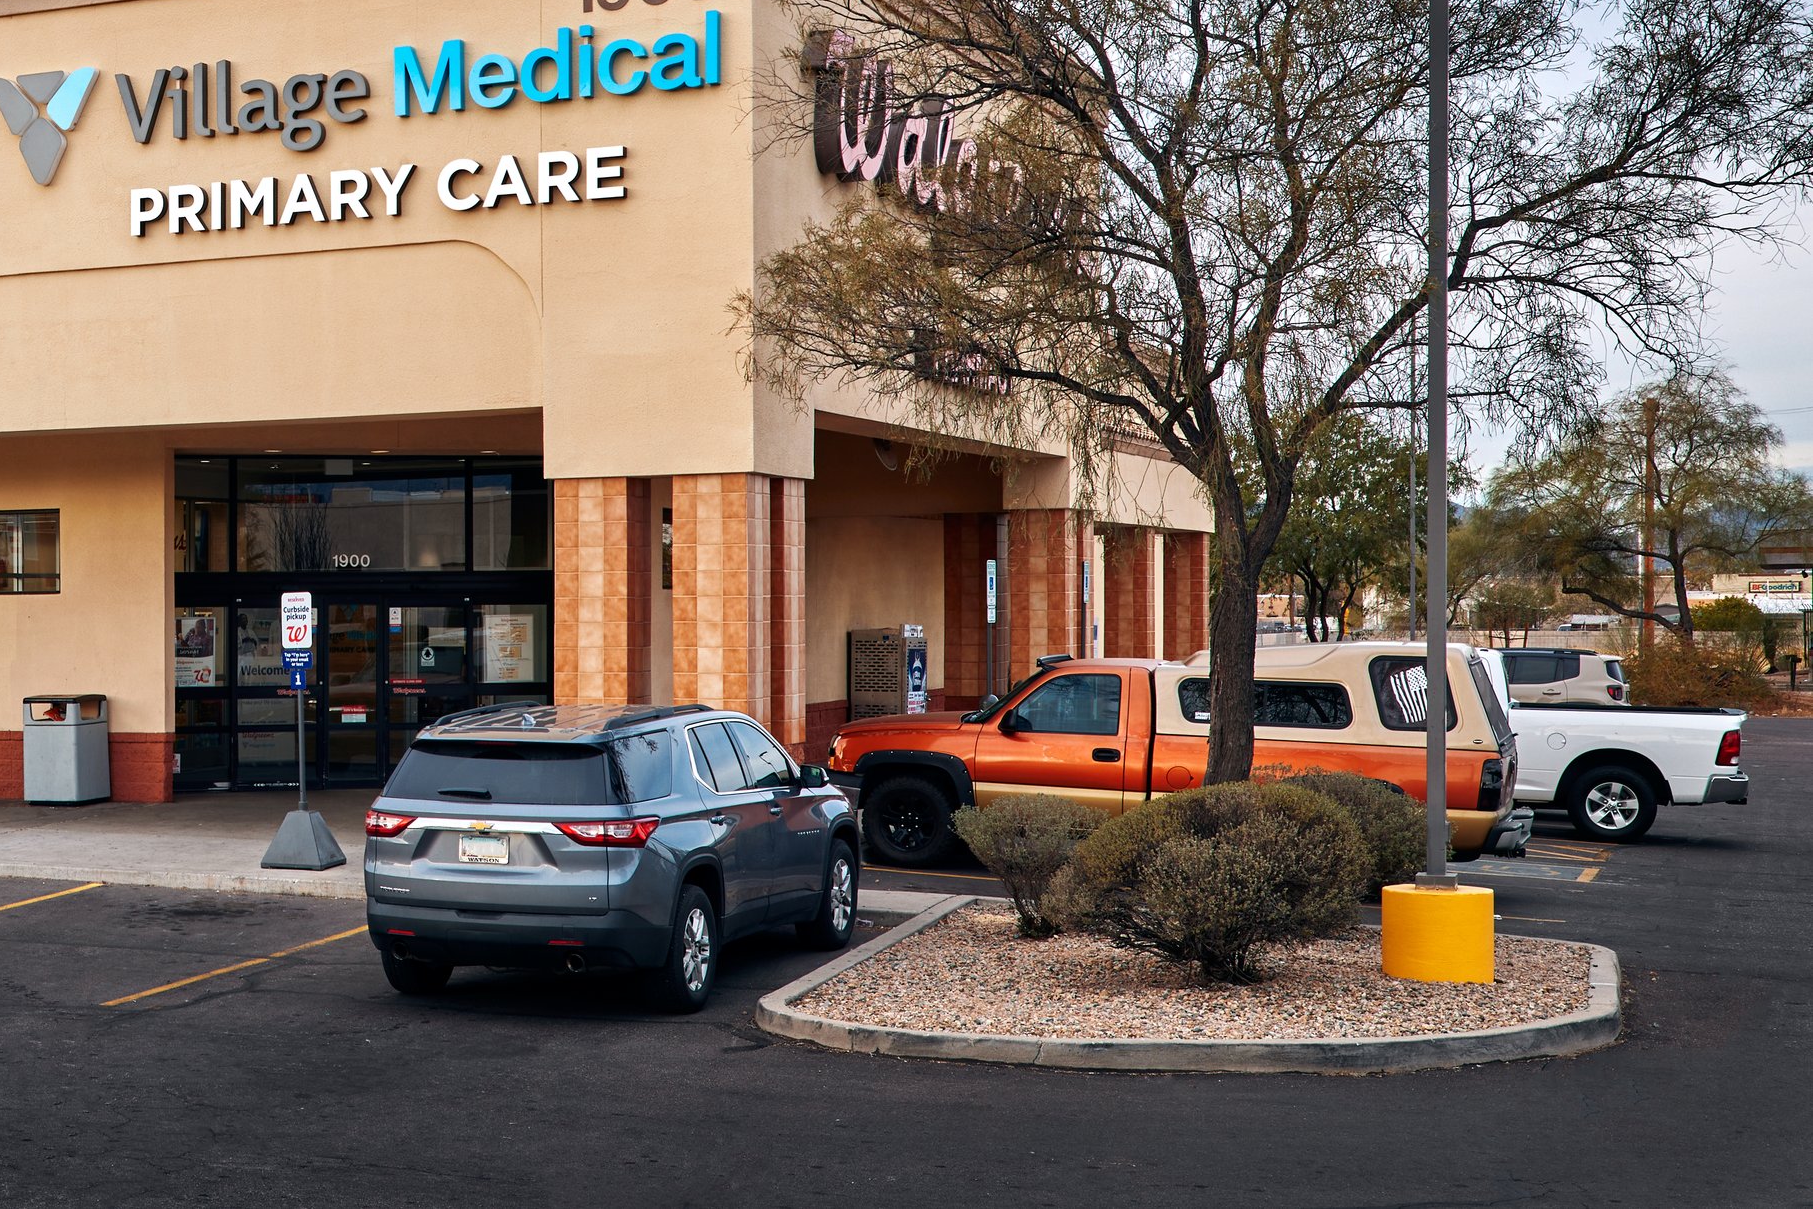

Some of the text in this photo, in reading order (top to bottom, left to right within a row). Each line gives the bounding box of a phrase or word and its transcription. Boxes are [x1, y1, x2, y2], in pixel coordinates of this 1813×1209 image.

[115, 10, 721, 153] Village Medical
[130, 145, 627, 237] PRIMARY CARE
[332, 554, 371, 568] 1900
